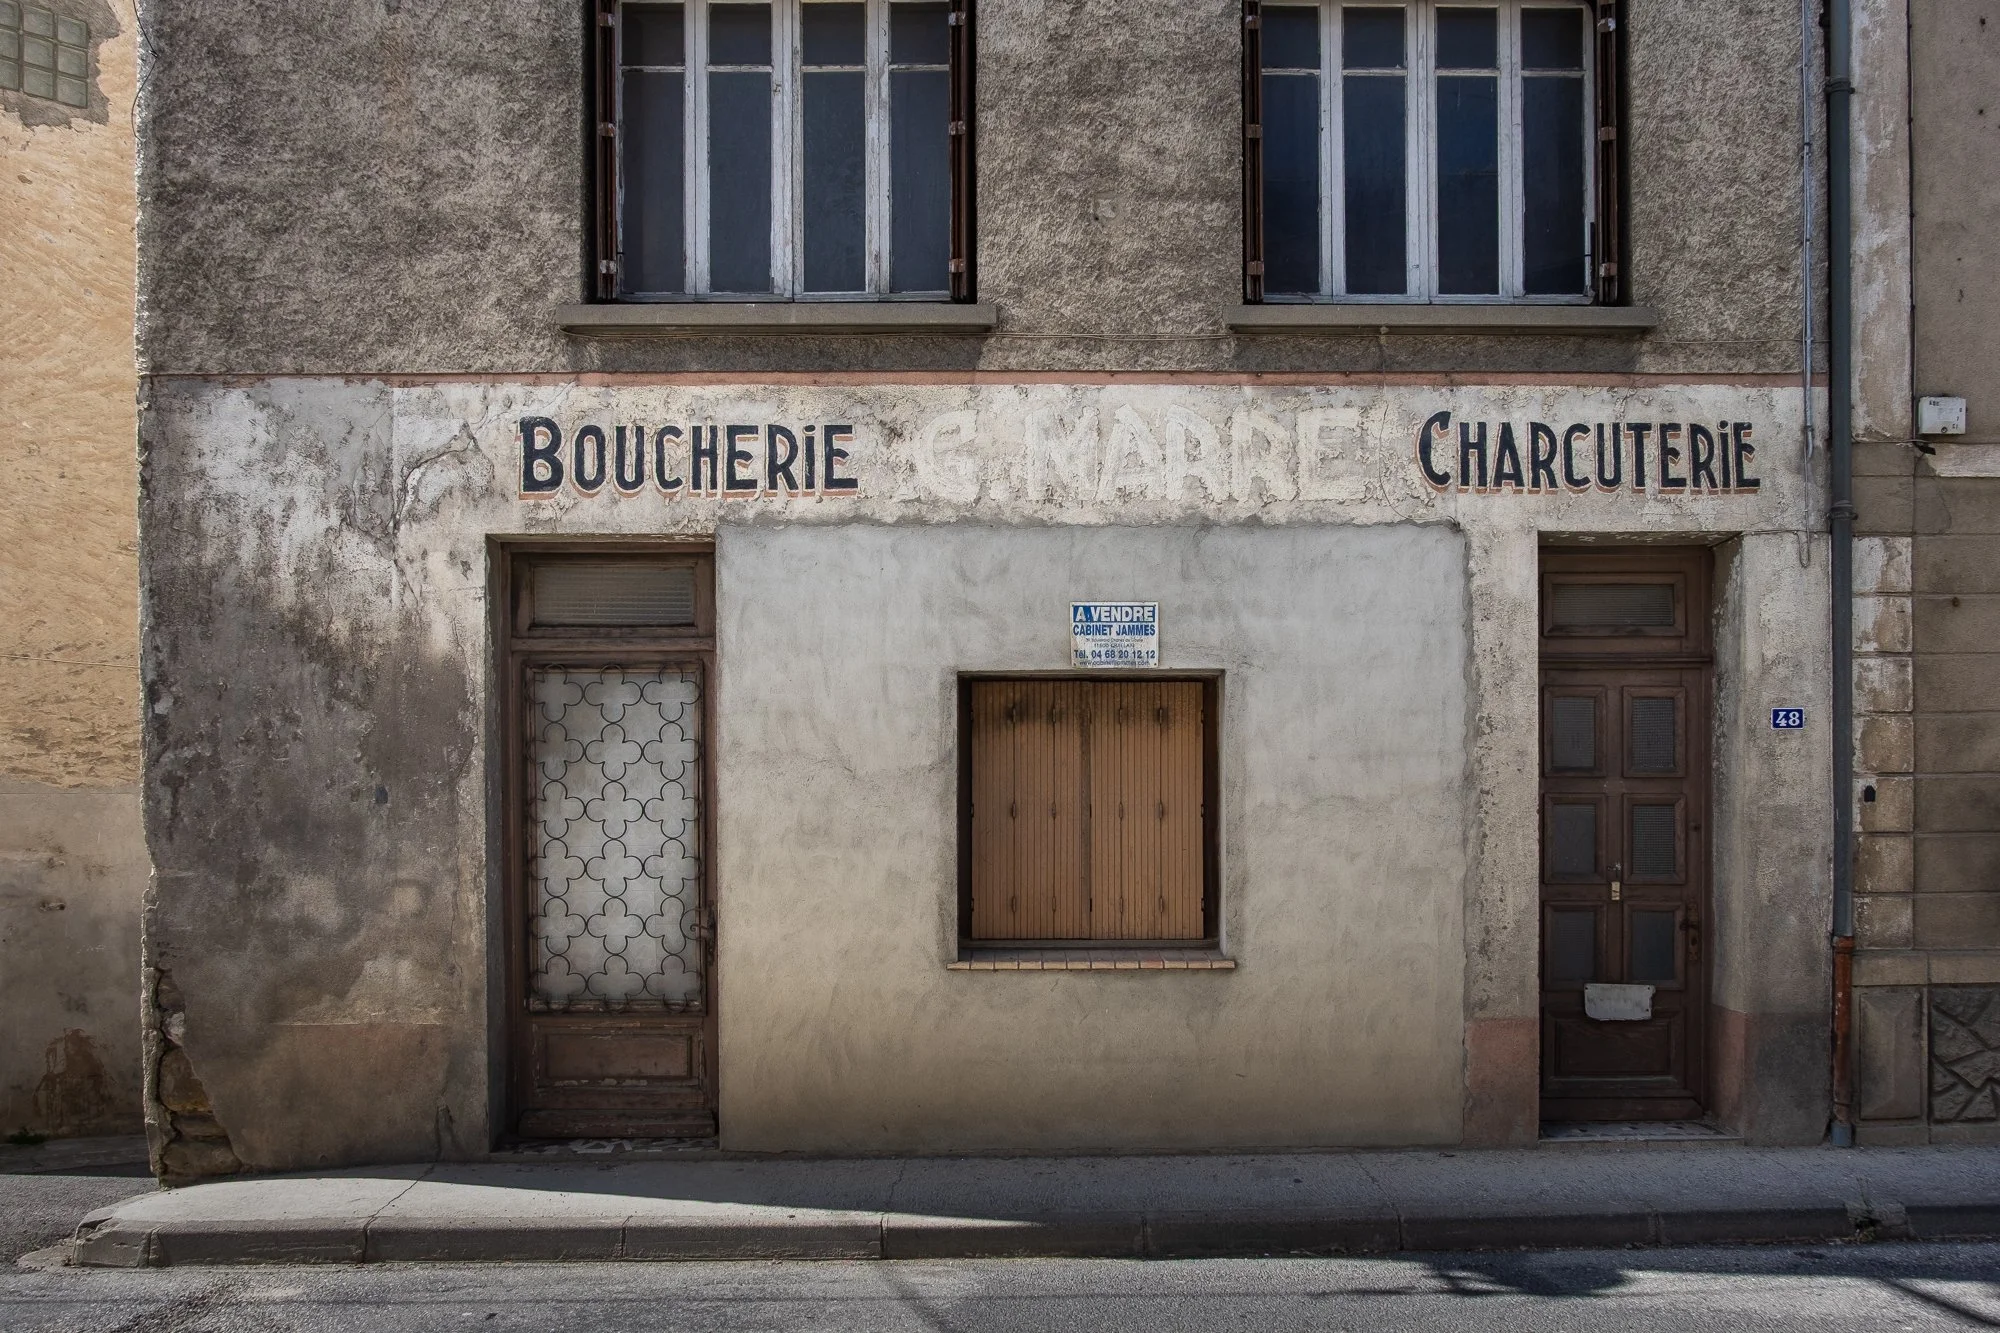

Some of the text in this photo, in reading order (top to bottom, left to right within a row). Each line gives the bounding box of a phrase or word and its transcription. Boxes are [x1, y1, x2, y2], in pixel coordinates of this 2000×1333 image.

[1090, 606, 1154, 622] VENDRE
[1073, 625, 1156, 636] CABINET JAMMES
[1074, 649, 1156, 659] Tél. 04 68 20 12 12
[1776, 711, 1800, 727] 48
